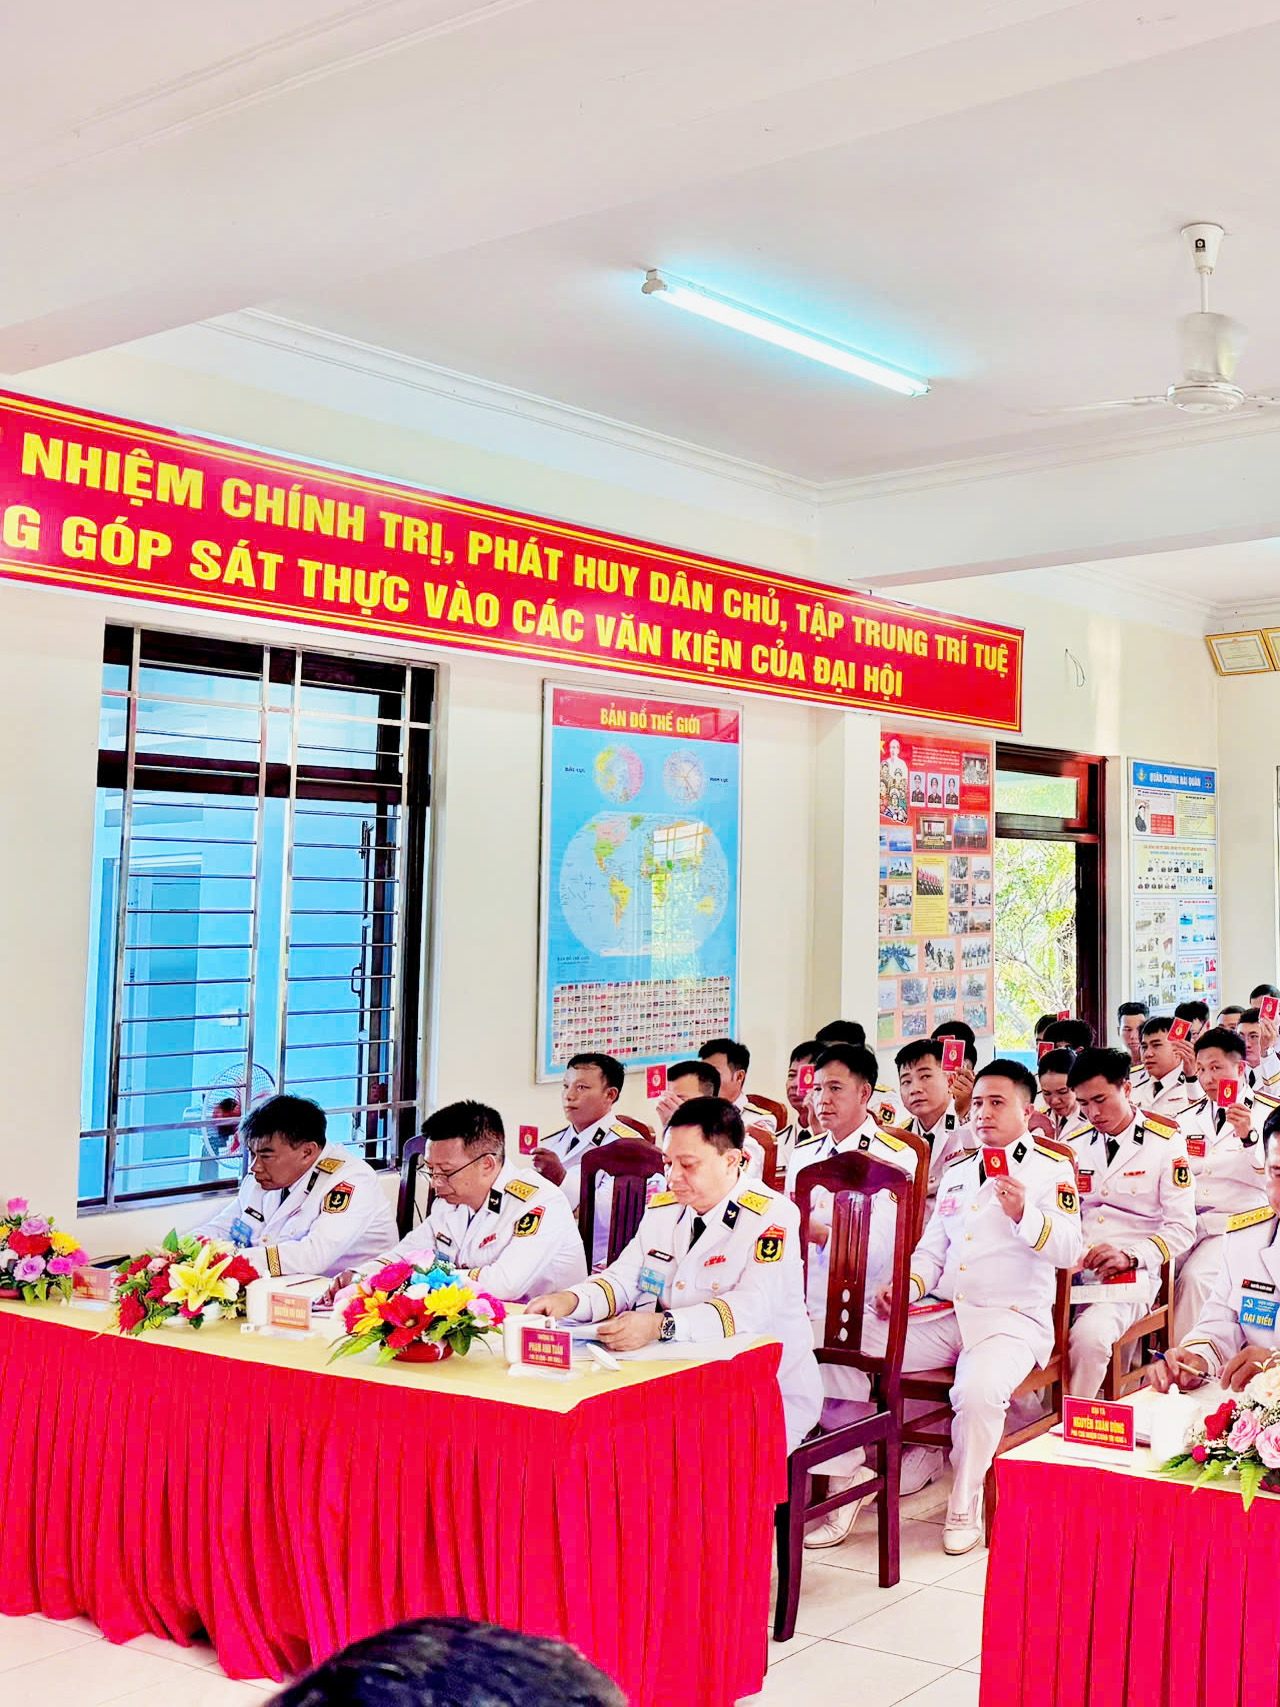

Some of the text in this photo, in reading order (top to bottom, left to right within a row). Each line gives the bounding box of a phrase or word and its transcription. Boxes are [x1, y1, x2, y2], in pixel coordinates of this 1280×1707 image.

[21, 432, 1010, 677] NHIỆM CHÍNH TRỊ, PHÁT HUY DÂN CHỦ, TẬP TRUNG TRÍ TUỆ
[61, 514, 173, 571] GÓP
[189, 538, 284, 591] SÁT
[297, 558, 410, 616] THỰC
[424, 580, 501, 629] VÀO
[512, 596, 585, 643] CÁC
[595, 612, 662, 657] VĂN
[672, 630, 742, 672] KIỆN
[751, 639, 806, 682] CỦA
[813, 658, 856, 695] ĐẠI
[864, 663, 903, 699] HỘI
[600, 702, 700, 734] BẢN ĐỒ THẾ GIỚI
